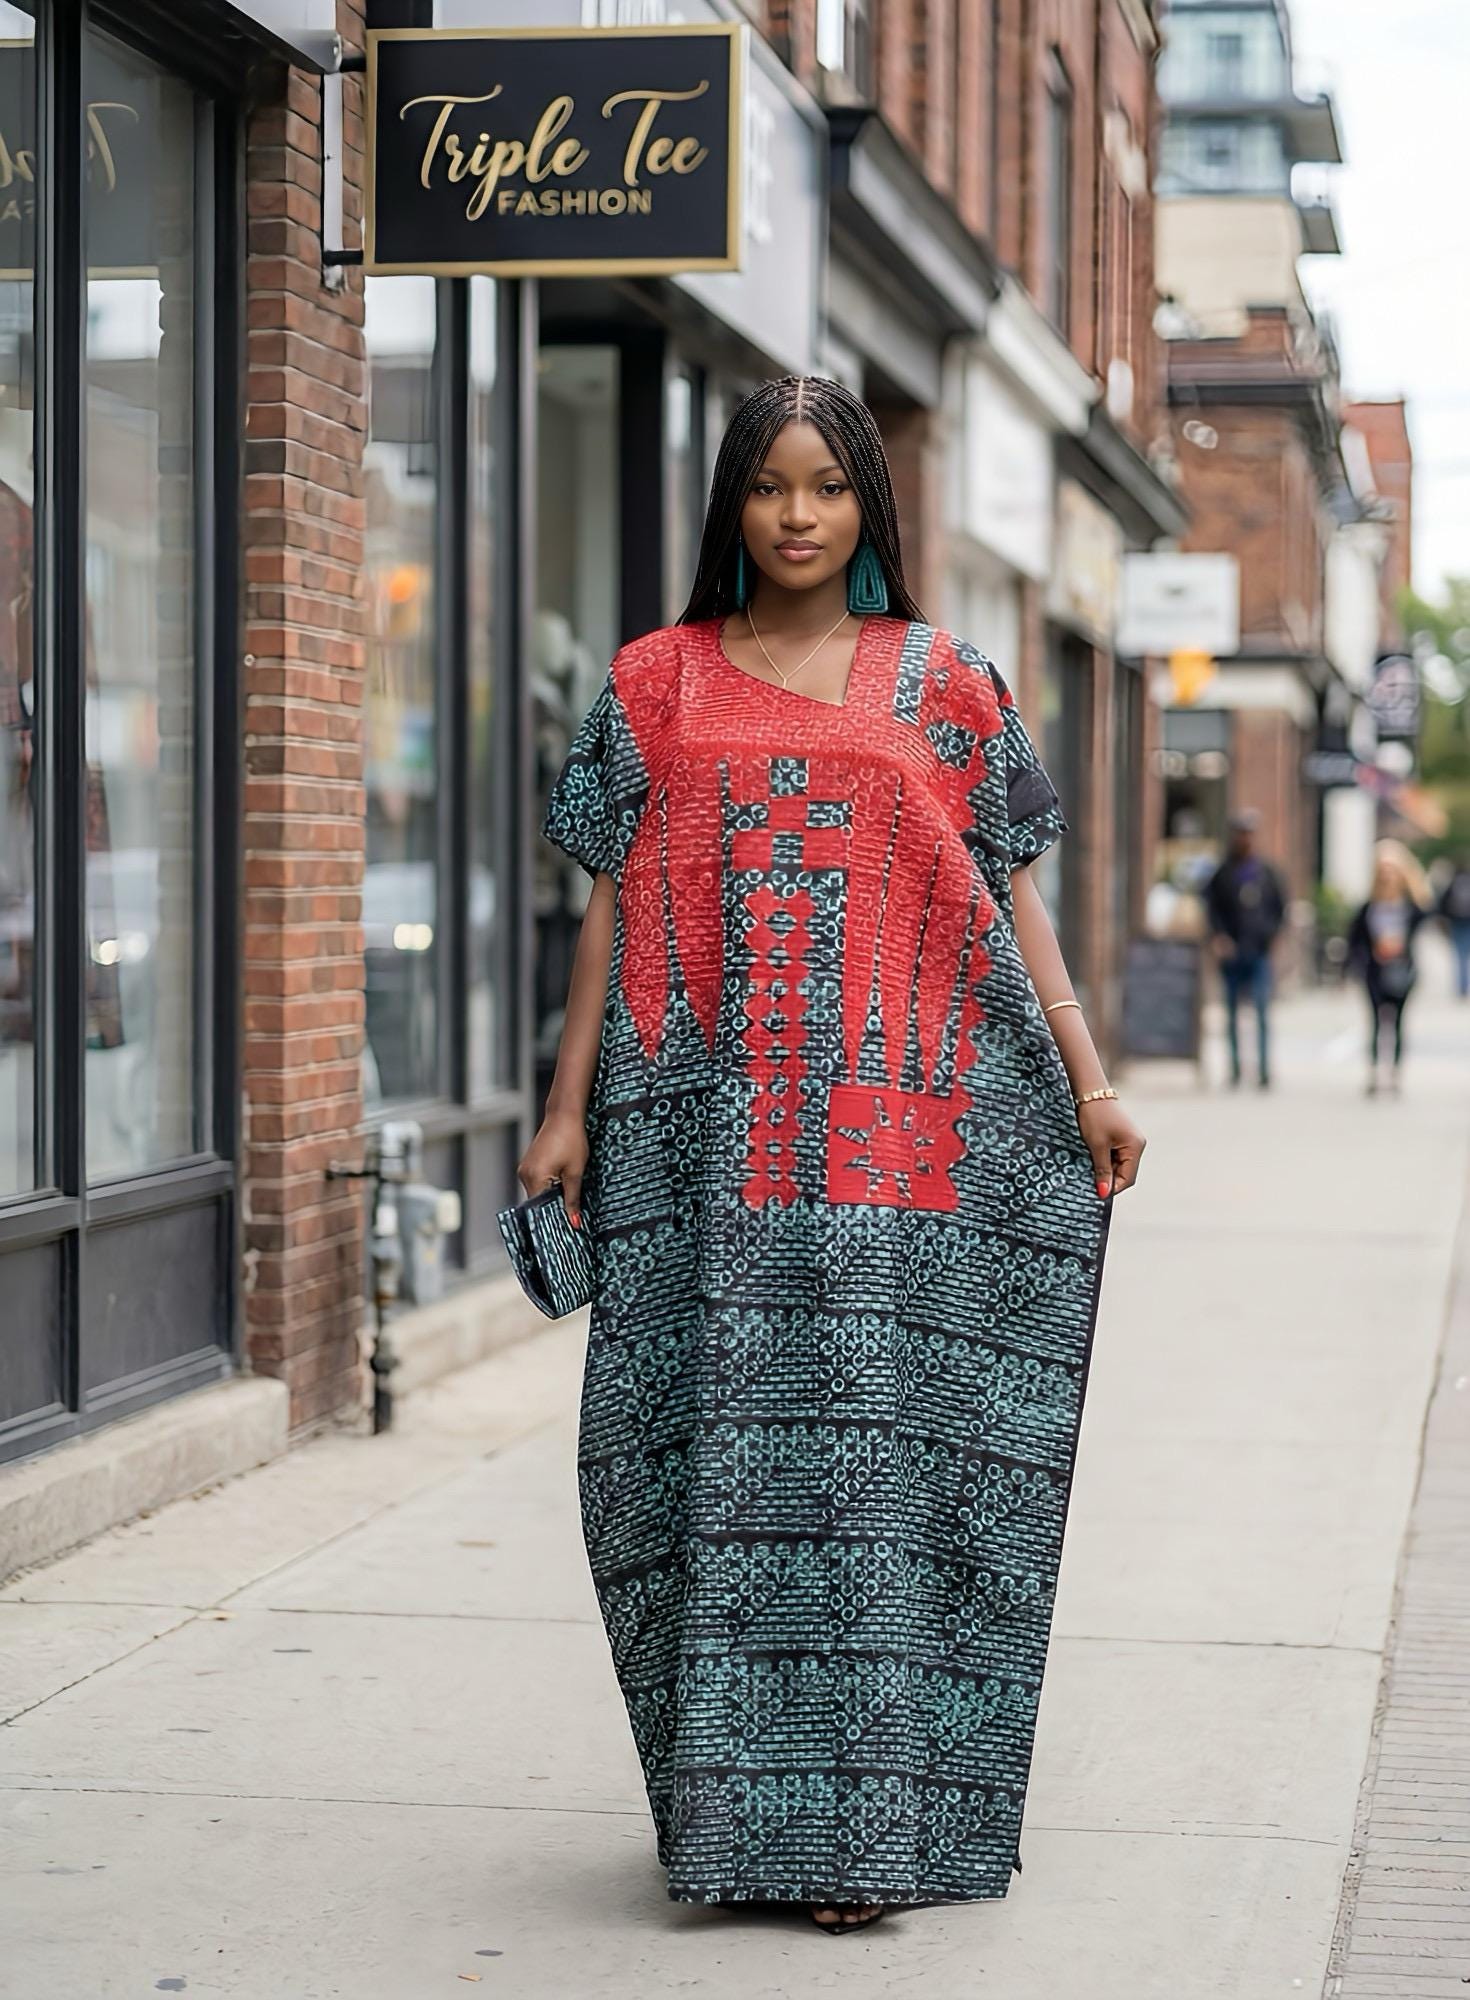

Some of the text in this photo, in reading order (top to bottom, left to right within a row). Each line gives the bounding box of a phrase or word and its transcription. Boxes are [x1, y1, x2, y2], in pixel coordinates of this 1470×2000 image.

[399, 83, 591, 222] Triple
[602, 79, 710, 187] Tee
[497, 188, 652, 217] FASHION
